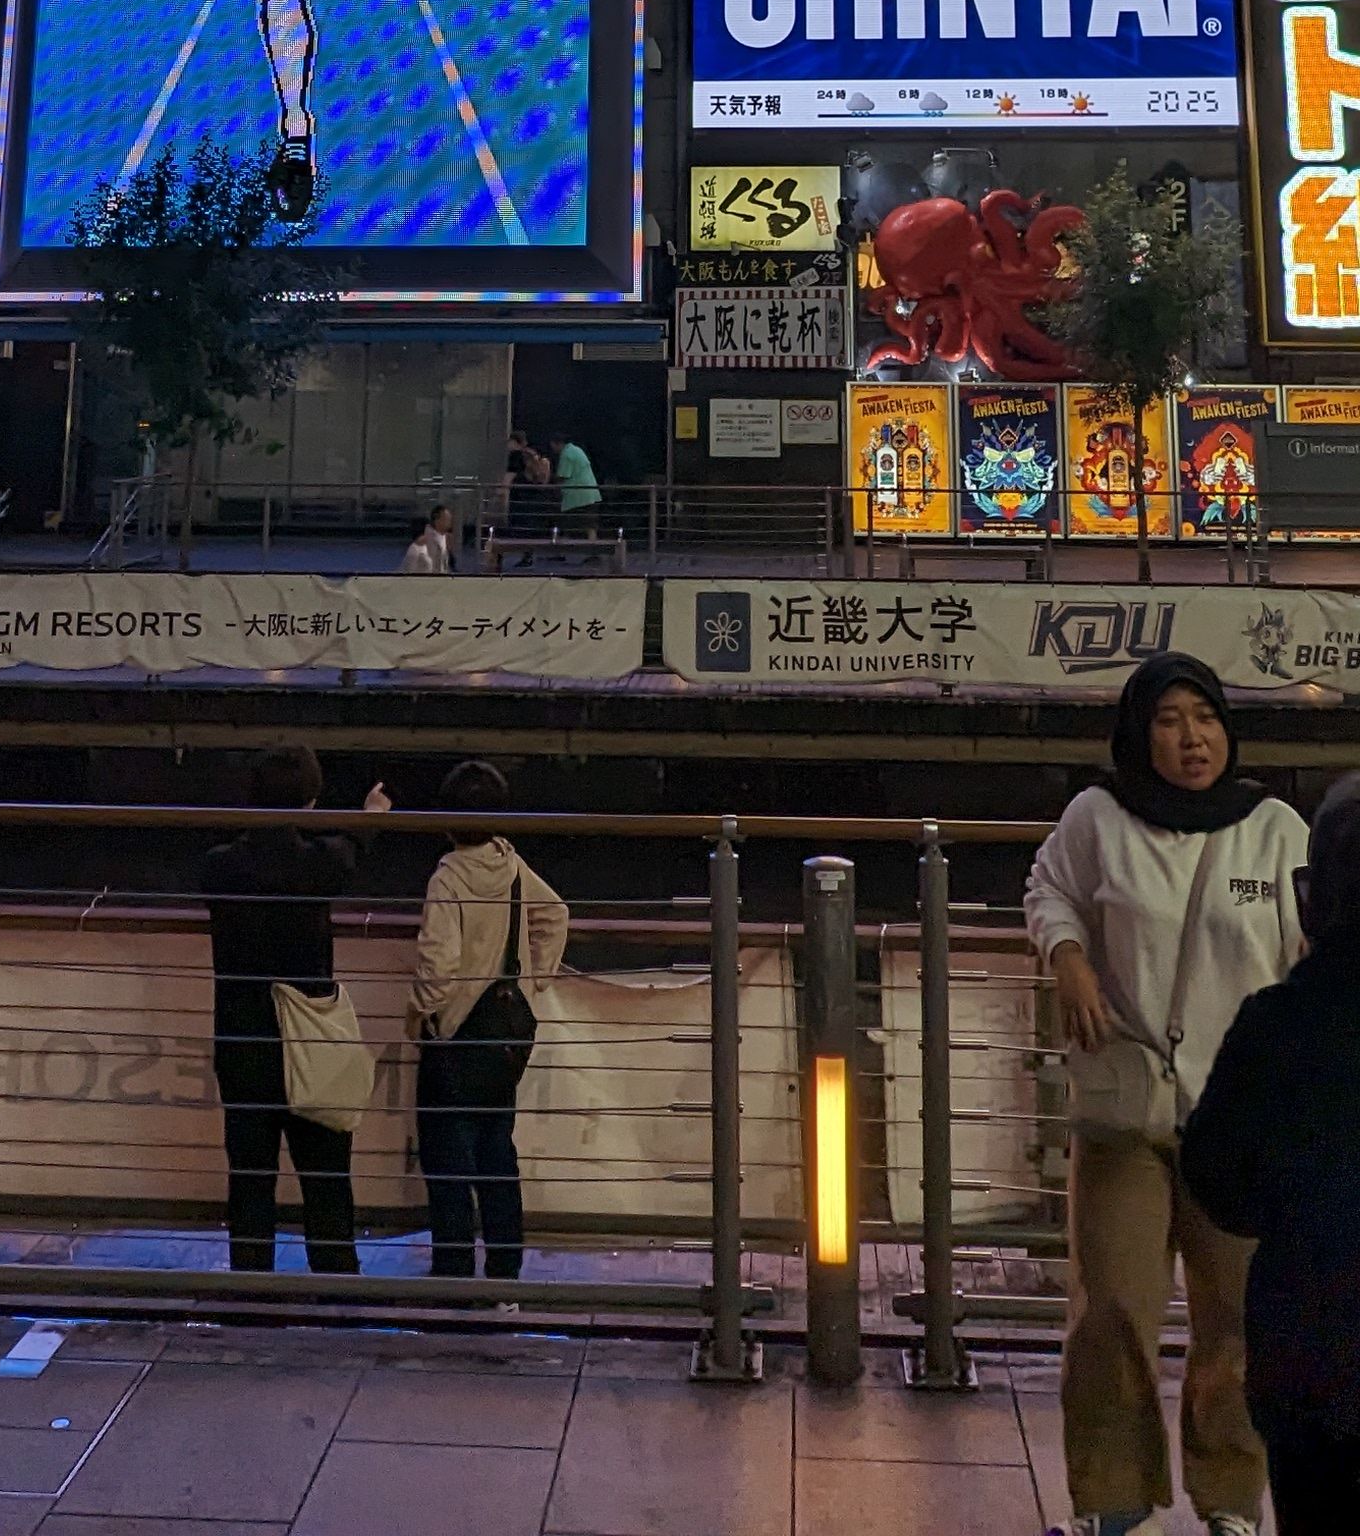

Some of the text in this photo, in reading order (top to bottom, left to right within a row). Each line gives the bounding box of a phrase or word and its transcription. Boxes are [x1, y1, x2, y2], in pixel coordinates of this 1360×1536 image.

[817, 88, 1069, 100] 24時 6時 12時 18時
[709, 94, 782, 116] 天気予報
[719, 177, 811, 238] くくる
[685, 300, 822, 354] 大阪に乾杯
[861, 399, 936, 417] AWAKEN FIESTA
[972, 399, 1049, 418] AWAKEN FIESTA
[1192, 402, 1268, 421] AWAKEN FIESTA
[1300, 403, 1341, 420] AWAKEN
[51, 612, 202, 637] RESORTS
[768, 595, 978, 646] 近畿大学
[768, 652, 975, 673] KINDAI UNIVERSITY
[1295, 644, 1339, 667] BIG
